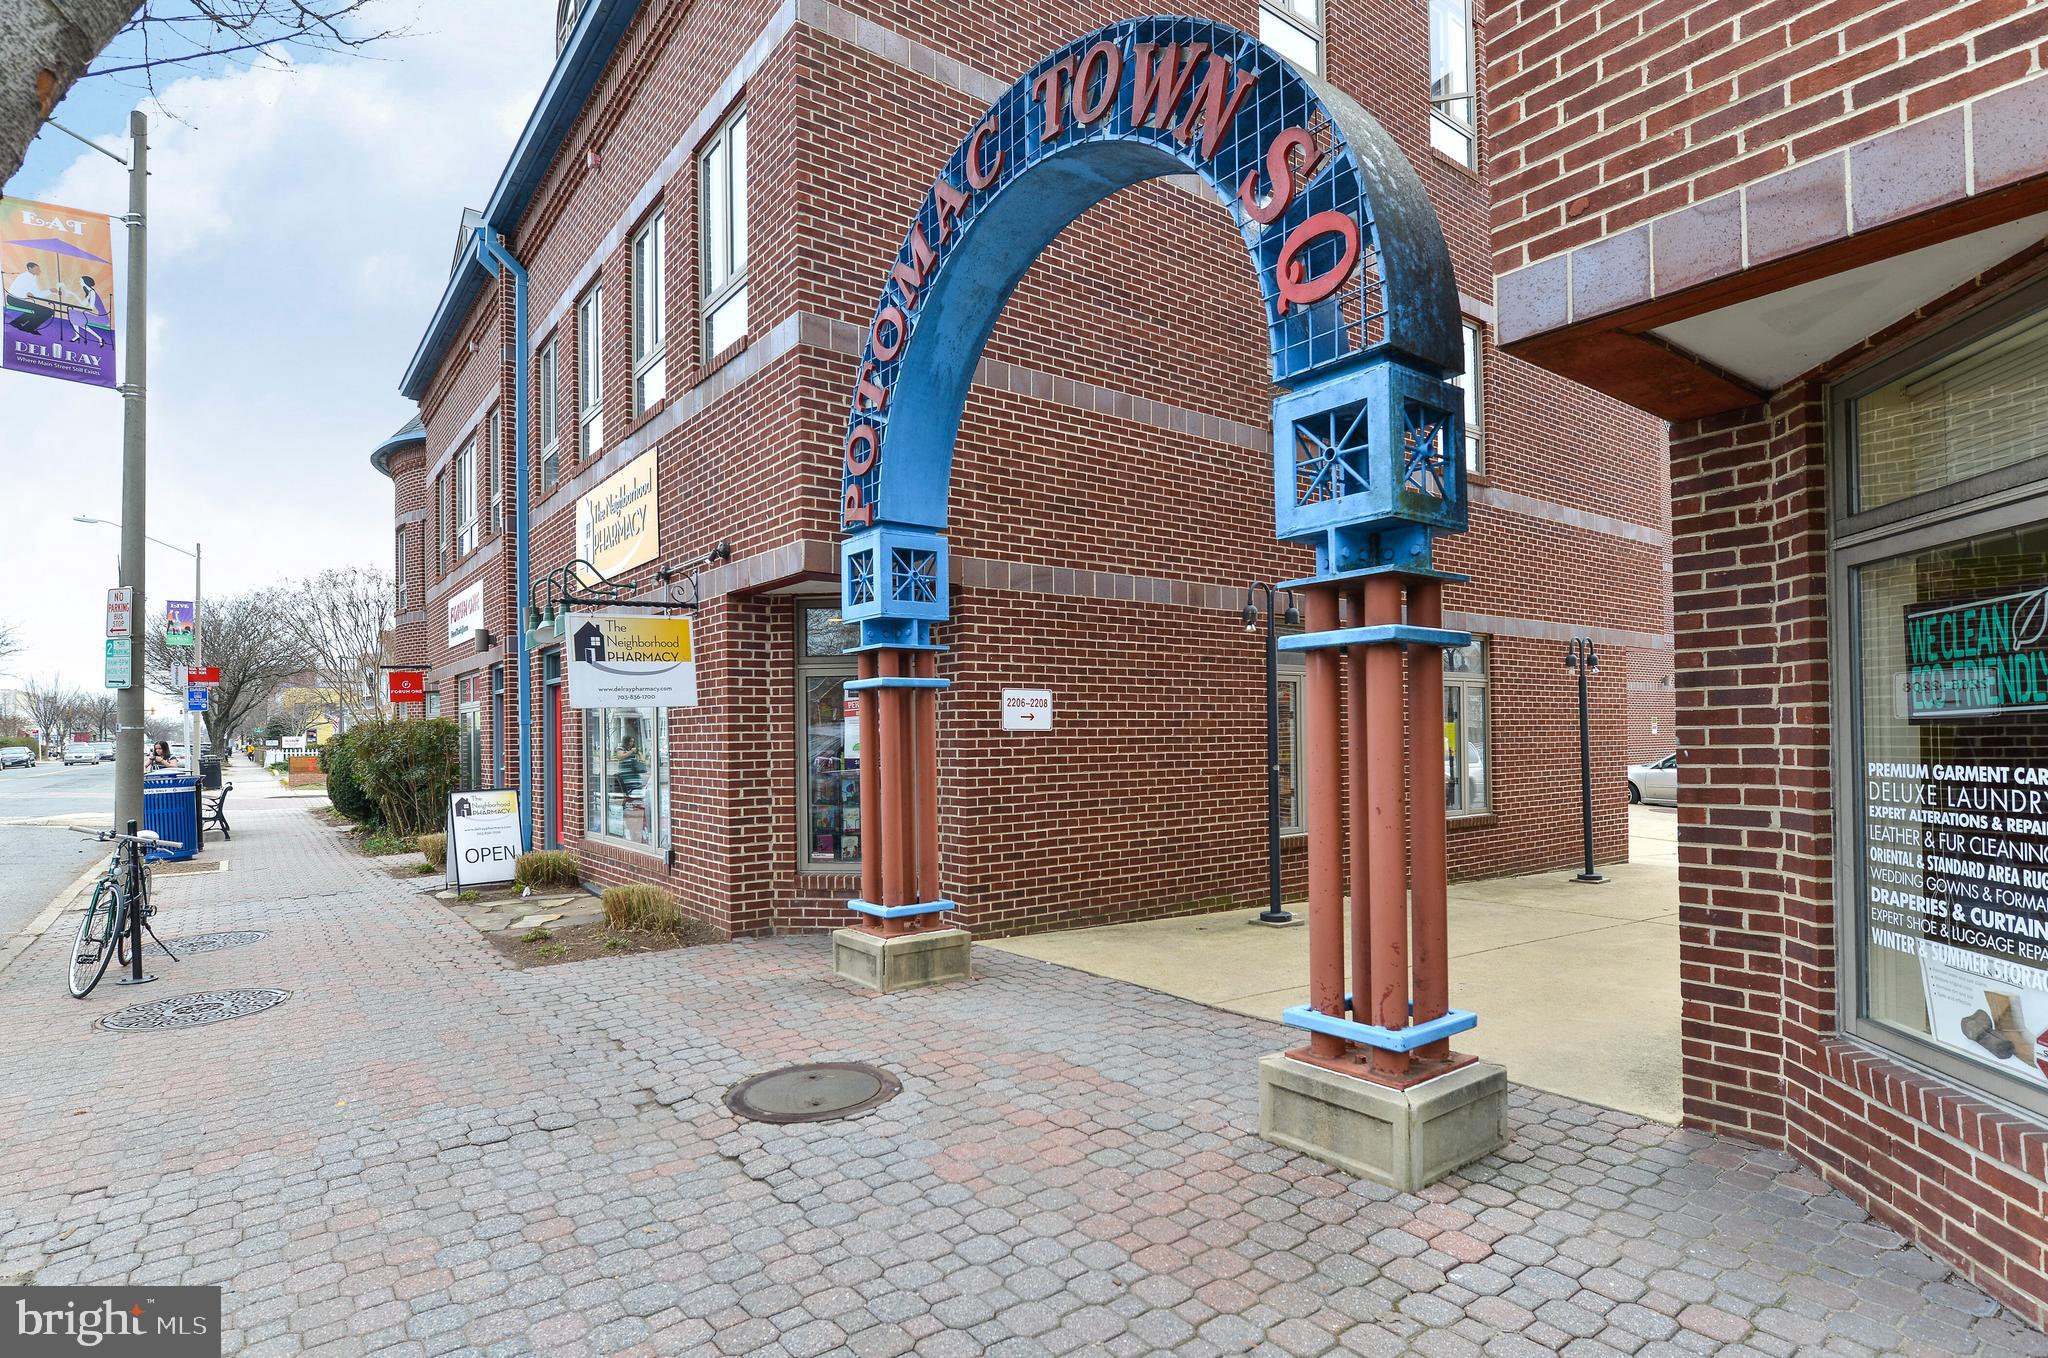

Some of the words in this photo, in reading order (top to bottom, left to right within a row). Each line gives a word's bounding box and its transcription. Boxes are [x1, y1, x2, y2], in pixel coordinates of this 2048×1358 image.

[21, 210, 87, 236] EAT
[845, 115, 1005, 527] POTOMAC
[1032, 40, 1258, 161] TOWN
[1238, 126, 1360, 315] SQ
[15, 341, 50, 359] DEL
[65, 350, 102, 366] RAY
[16, 356, 37, 364] Where
[37, 359, 53, 367] Main
[54, 363, 71, 372] Street
[594, 501, 606, 524] The
[605, 467, 652, 517] Neighborhood
[594, 504, 647, 555] PHARMACY
[108, 603, 130, 613] PARKING
[114, 592, 124, 602] NO
[112, 620, 125, 628] STOP
[605, 619, 627, 632] The
[1908, 617, 1939, 664] WE
[1940, 602, 2010, 660] CLEAN
[107, 642, 113, 655] 2
[606, 635, 679, 650] Neighborhood
[607, 652, 679, 662] PHARMACY
[598, 685, 672, 693] www.delraypharmacy.com
[1911, 663, 1946, 710] ECO
[847, 701, 860, 709] PER
[1007, 697, 1048, 708] 2206-2208
[1868, 762, 1929, 779] PREMIUM
[1932, 764, 2010, 784] GARMENT
[472, 800, 511, 810] Neighborhood
[1869, 781, 1937, 806] DELUXE
[472, 808, 511, 816] PHARMACY
[1869, 805, 1906, 820] EXPERT
[1909, 808, 1989, 830] ALTERATIONS
[1991, 816, 2004, 831] &
[2006, 818, 2048, 836] REPAI
[1870, 824, 1921, 846] LEATHER
[1924, 830, 1936, 849] &
[1939, 832, 1966, 853] FUR
[465, 845, 516, 864] OPEN
[1870, 846, 1914, 868] ORIENTAL
[1916, 854, 1925, 870] &
[1927, 855, 1985, 879] STANDARD
[1987, 864, 2021, 886] AREA
[1870, 866, 1924, 888] WEDDING
[1926, 877, 1979, 900] GOWNS
[1982, 886, 1993, 903] &
[1871, 886, 1948, 918] DRAPERIES
[1952, 903, 1967, 923] &
[1970, 907, 2048, 941] CURTAIN
[1871, 907, 1904, 927] EXPERT
[1906, 915, 1938, 935] SHOE
[1940, 923, 1950, 938] &
[1951, 925, 2015, 955] LUGGAGE
[1871, 926, 1915, 955] WINTER
[1918, 940, 1928, 959] &
[1931, 942, 1993, 977] SUMMER
